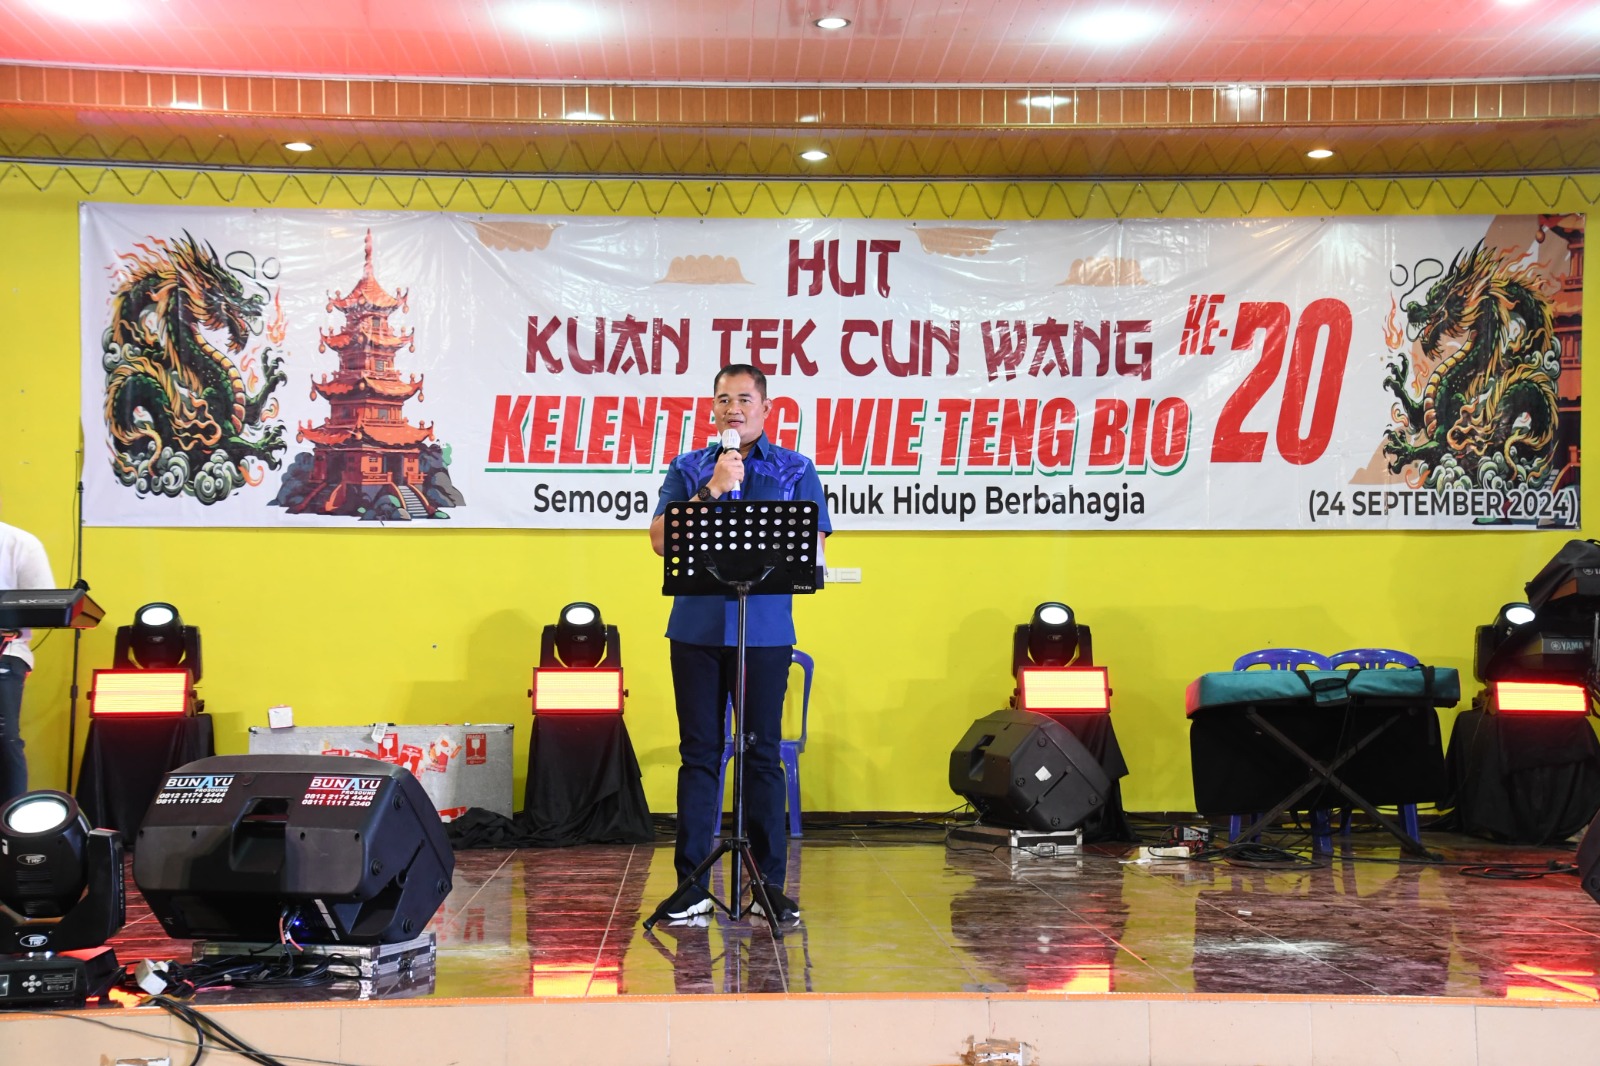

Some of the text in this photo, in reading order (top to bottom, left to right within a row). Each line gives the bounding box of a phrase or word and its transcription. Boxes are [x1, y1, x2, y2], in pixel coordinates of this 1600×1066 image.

[787, 238, 901, 298] HUT
[525, 313, 1153, 381] KUAN TEK CUN WANG
[1179, 294, 1353, 465] KE- 20
[487, 394, 1192, 469] KELENTEG WIE TENG BIO
[533, 483, 1146, 521] Semoga hluk Hidup Berbahagia
[1308, 489, 1579, 524] (24 SEPTEMBER 2024)
[1560, 640, 1591, 651] YAMA
[165, 775, 234, 789] BUNAYU
[309, 777, 382, 790] BUNAYU
